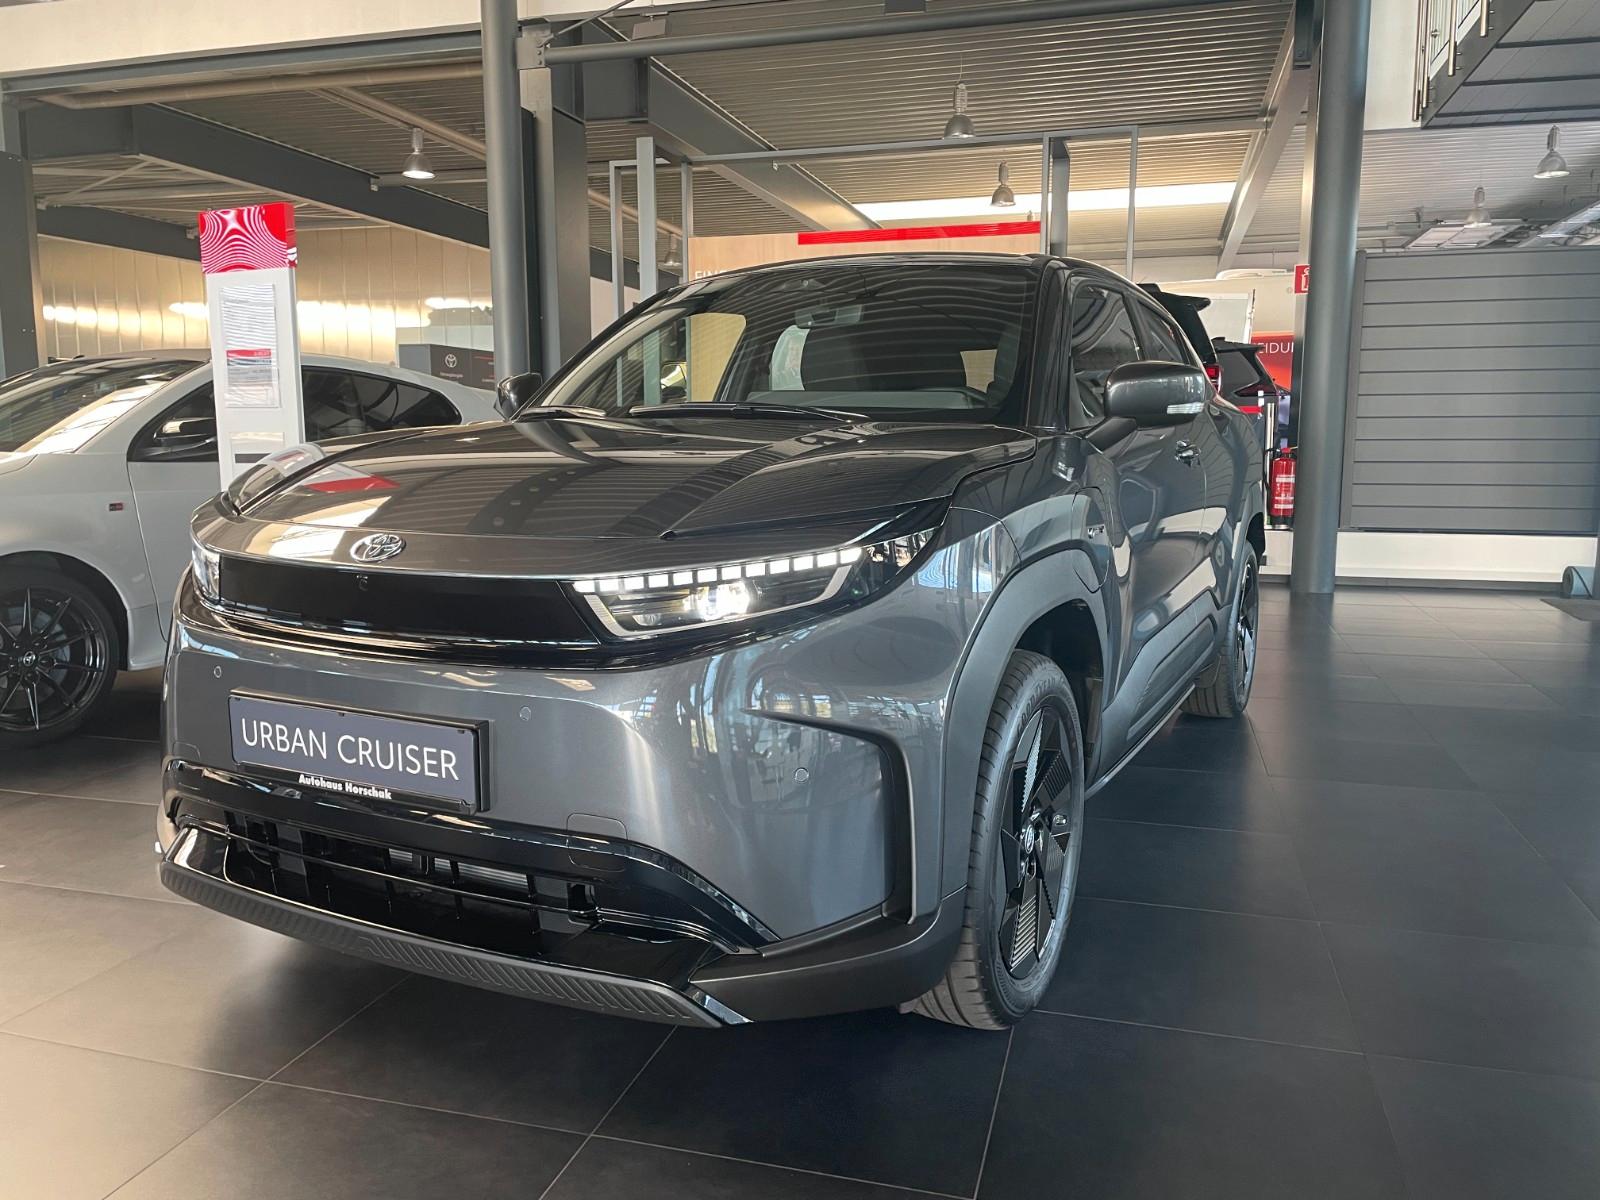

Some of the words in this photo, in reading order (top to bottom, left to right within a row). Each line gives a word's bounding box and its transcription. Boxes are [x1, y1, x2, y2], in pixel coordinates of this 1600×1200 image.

[240, 717, 328, 760] URBAN
[337, 734, 460, 781] CRUISER
[298, 774, 343, 791] Autohaus
[345, 782, 393, 800] Horschak
